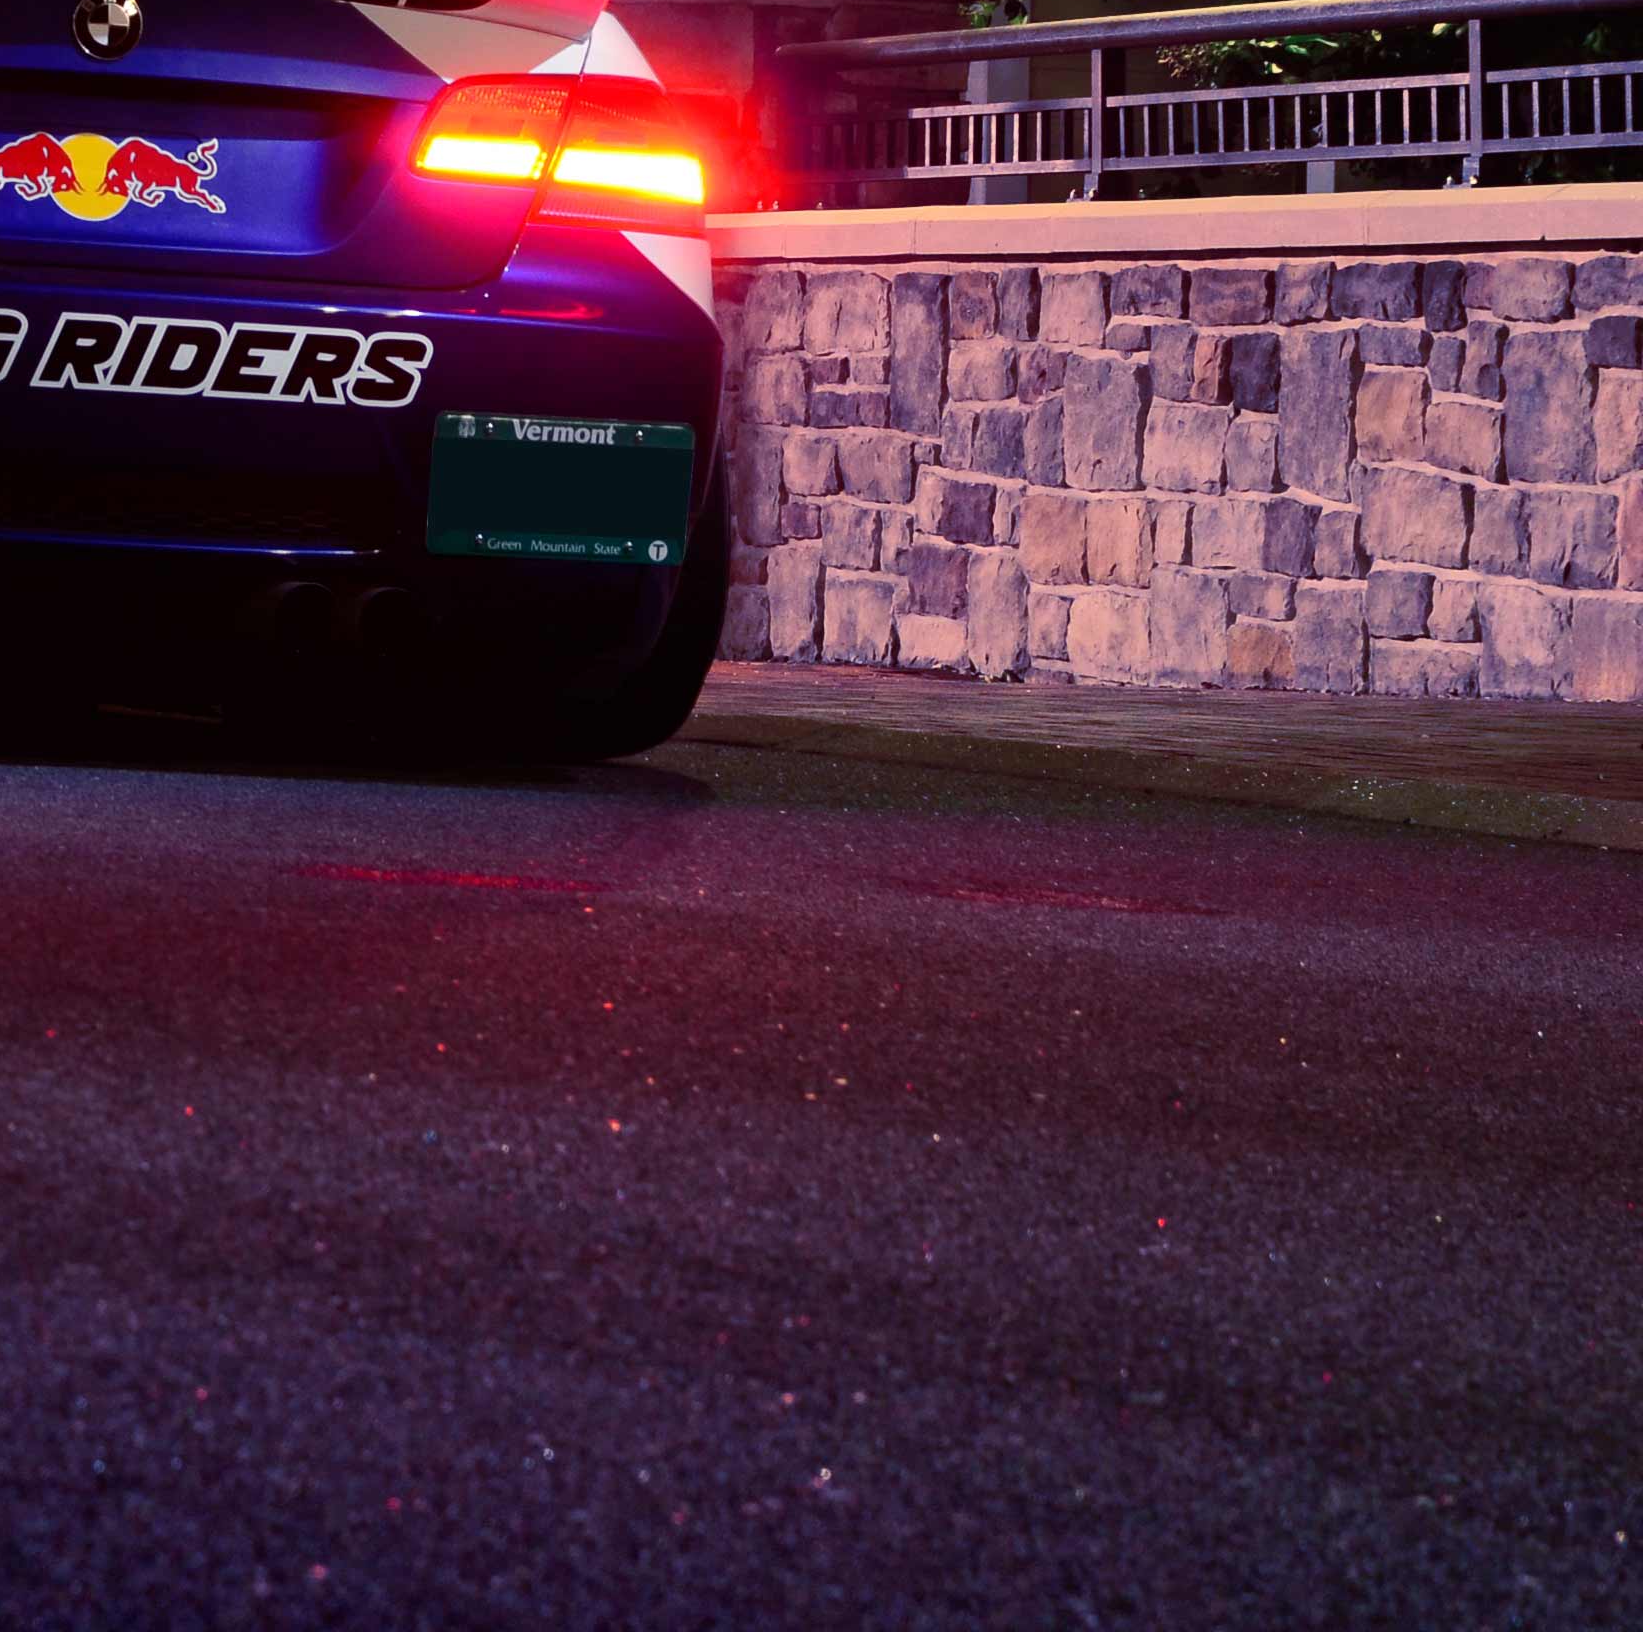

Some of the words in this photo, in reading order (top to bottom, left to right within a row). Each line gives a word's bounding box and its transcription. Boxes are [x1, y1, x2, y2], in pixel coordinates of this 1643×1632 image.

[29, 312, 435, 408] RIDERS
[512, 419, 617, 445] Vermont
[486, 537, 522, 551] Green
[530, 539, 586, 554] Mountain
[593, 542, 621, 556] State
